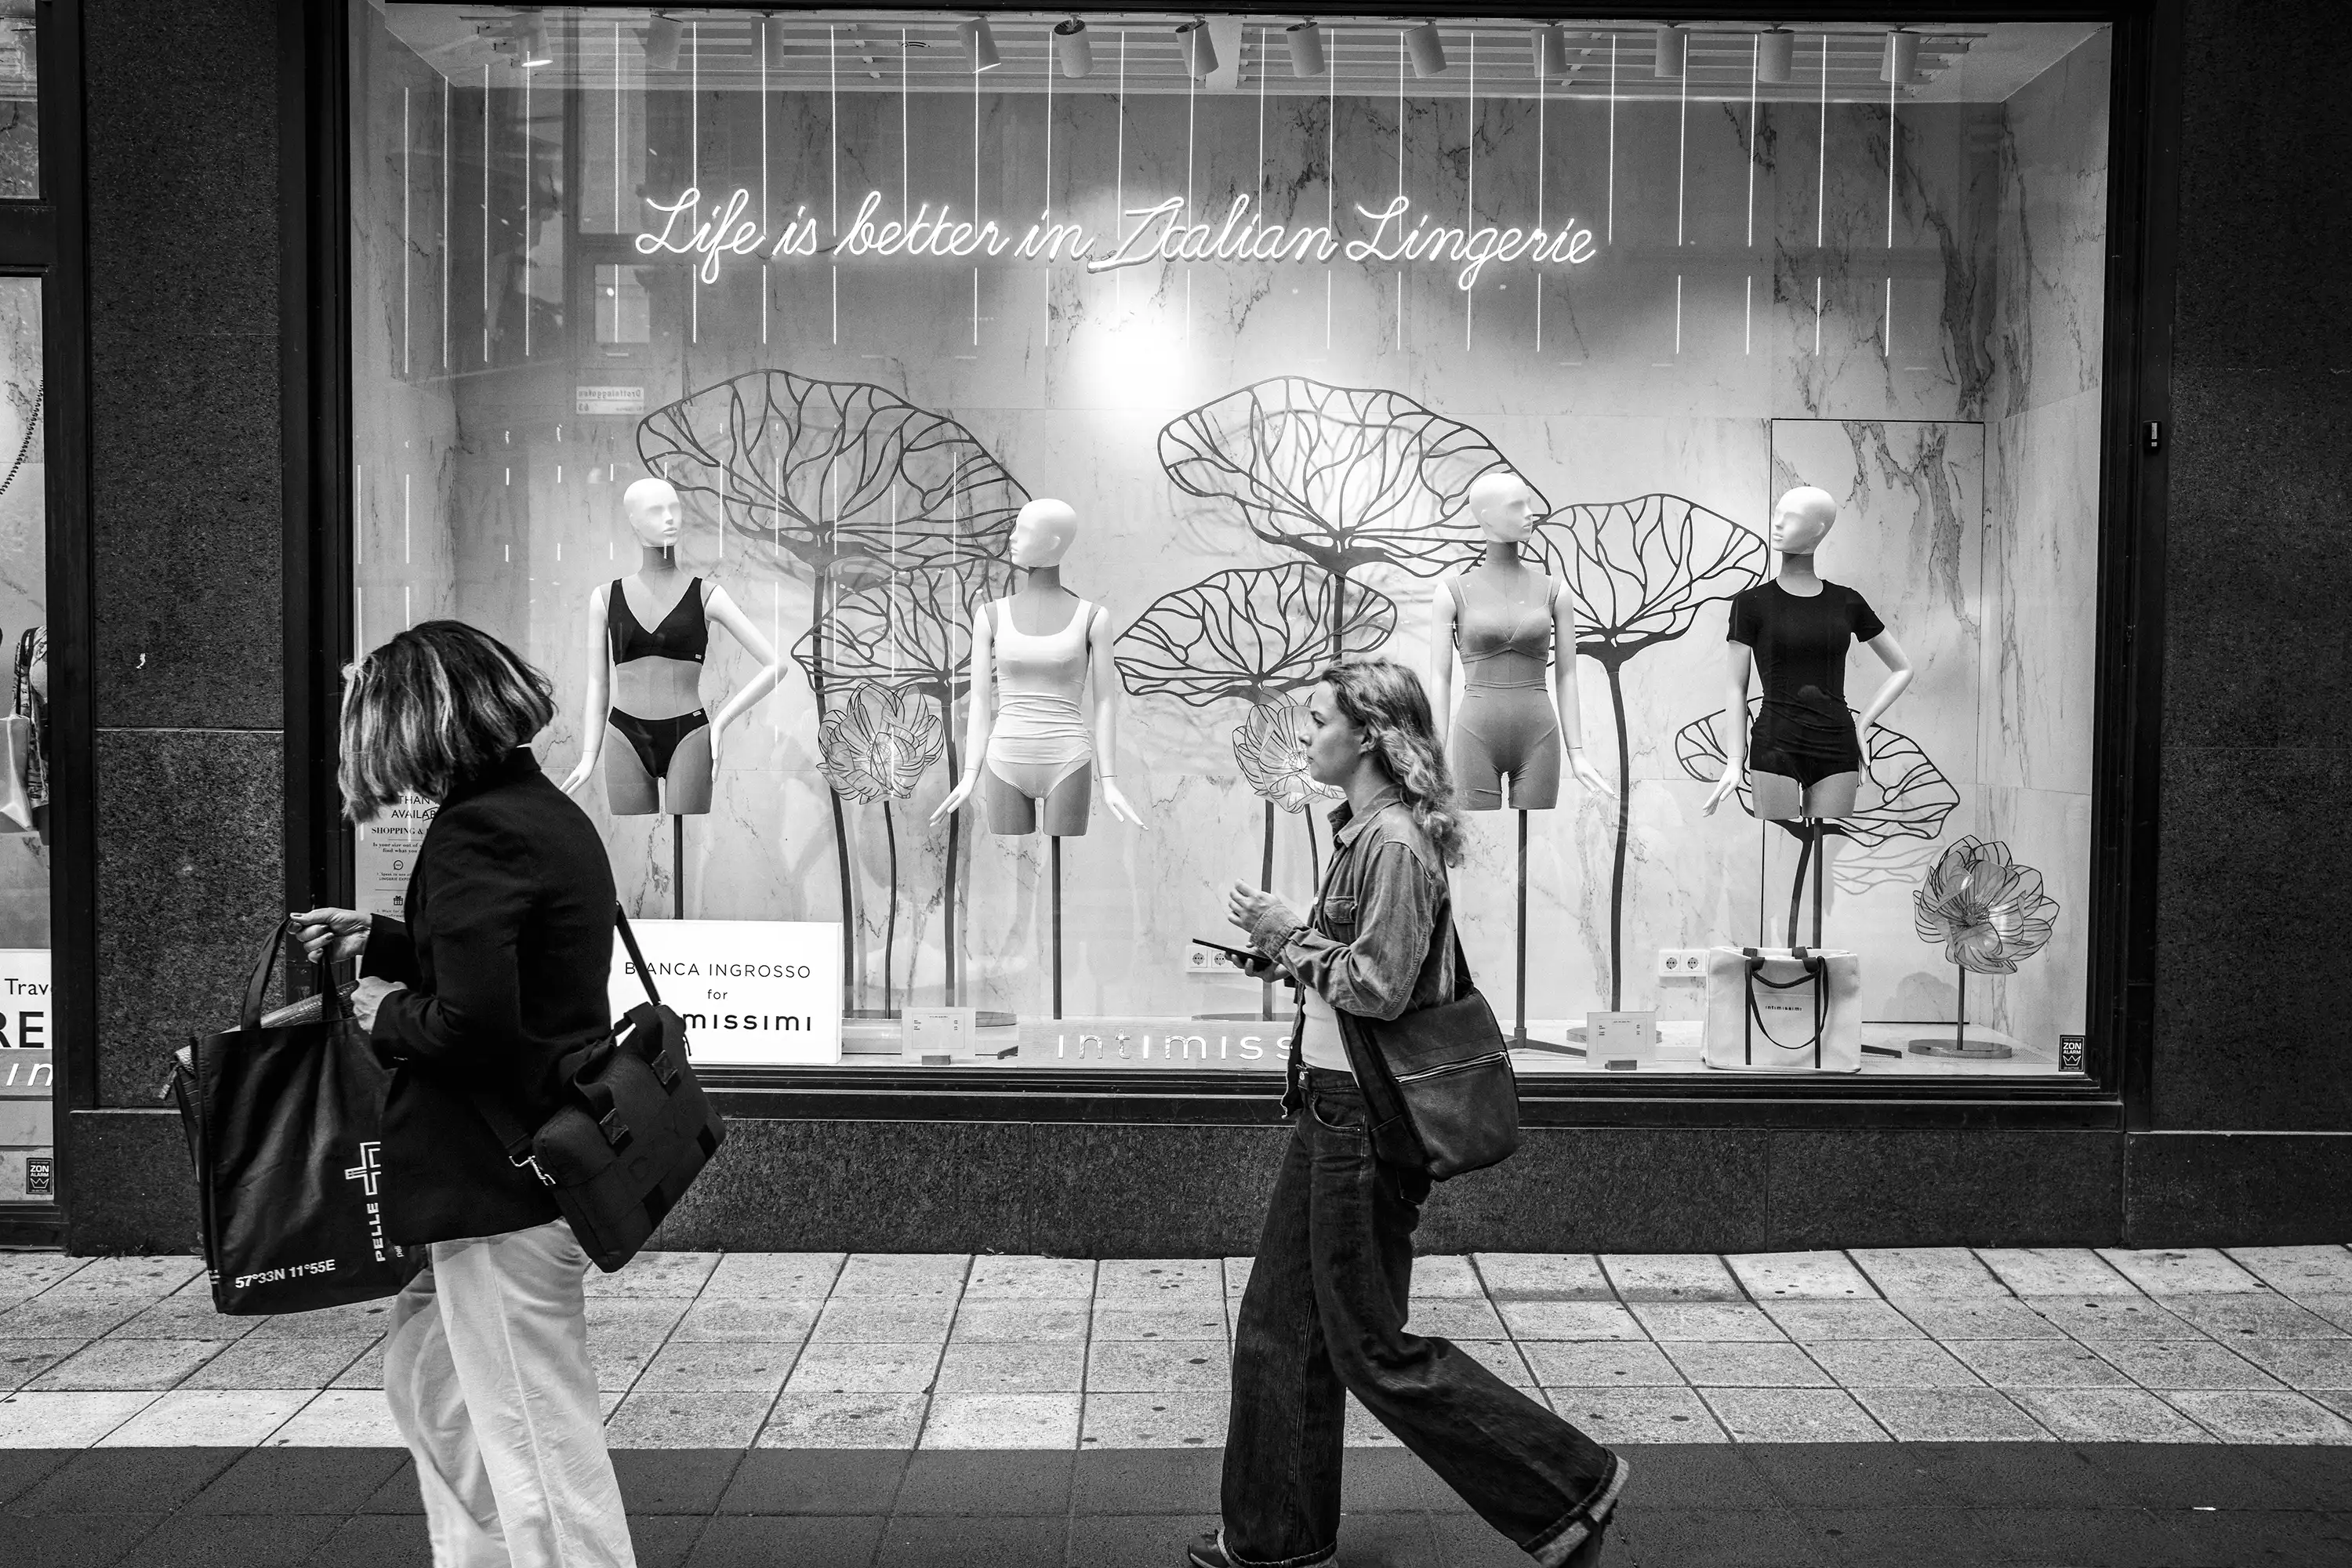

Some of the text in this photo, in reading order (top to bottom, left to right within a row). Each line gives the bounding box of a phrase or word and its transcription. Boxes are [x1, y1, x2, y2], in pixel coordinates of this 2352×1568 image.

[635, 188, 1595, 290] Life is better in Italian Lingerie
[399, 795, 430, 804] THAN
[391, 809, 436, 818] AVAILAB
[625, 962, 811, 978] BANCA INGROSSO
[4, 978, 52, 995] Trav
[707, 989, 728, 1000] for
[682, 1013, 811, 1032] missimi
[1058, 1029, 1293, 1060] intimiss
[6, 1062, 53, 1087] in
[366, 1202, 386, 1262] PELLE
[234, 1268, 285, 1289] 57°33N
[289, 1259, 336, 1278] 11°55E
